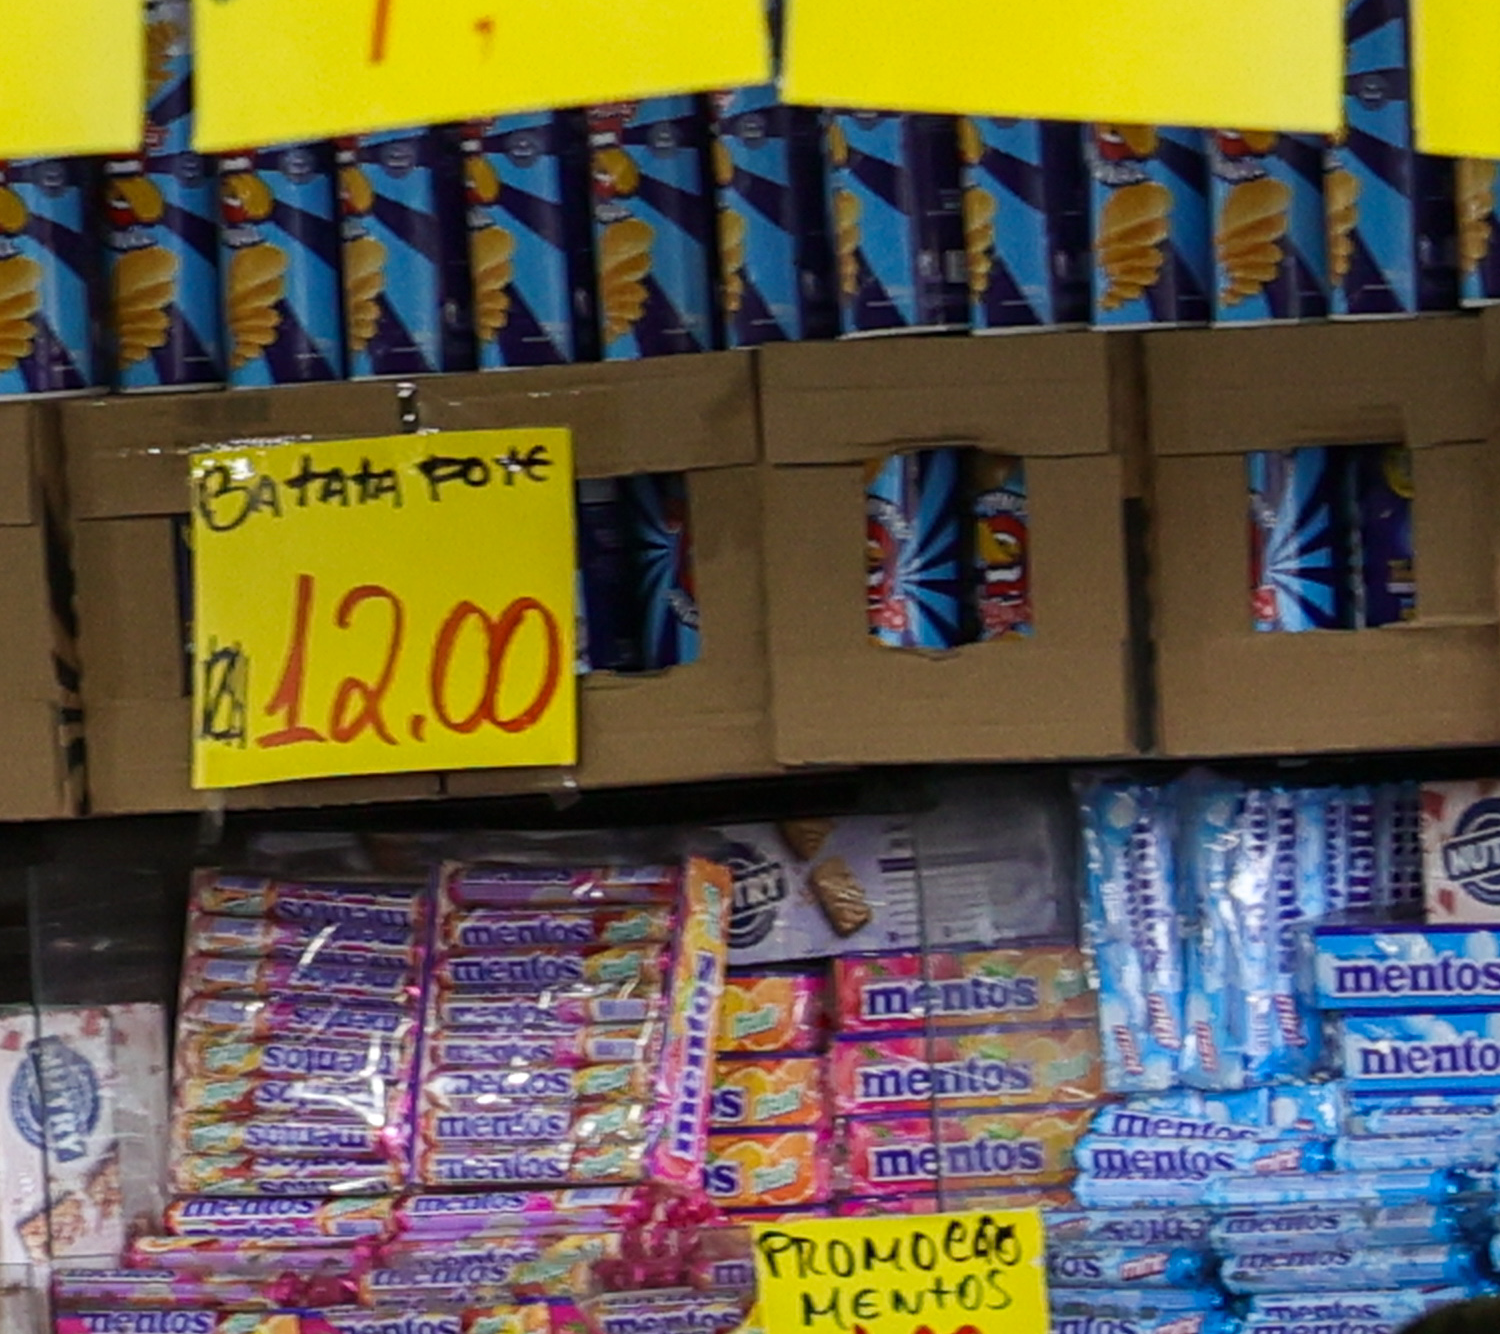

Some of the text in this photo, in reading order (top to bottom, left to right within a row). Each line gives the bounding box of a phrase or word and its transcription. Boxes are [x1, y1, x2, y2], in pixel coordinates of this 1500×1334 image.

[461, 917, 593, 948] mentos
[865, 975, 1040, 1017] mentos
[859, 1063, 1033, 1102] mentos
[872, 1140, 1044, 1179] mentos
[1089, 1144, 1236, 1174] mentos
